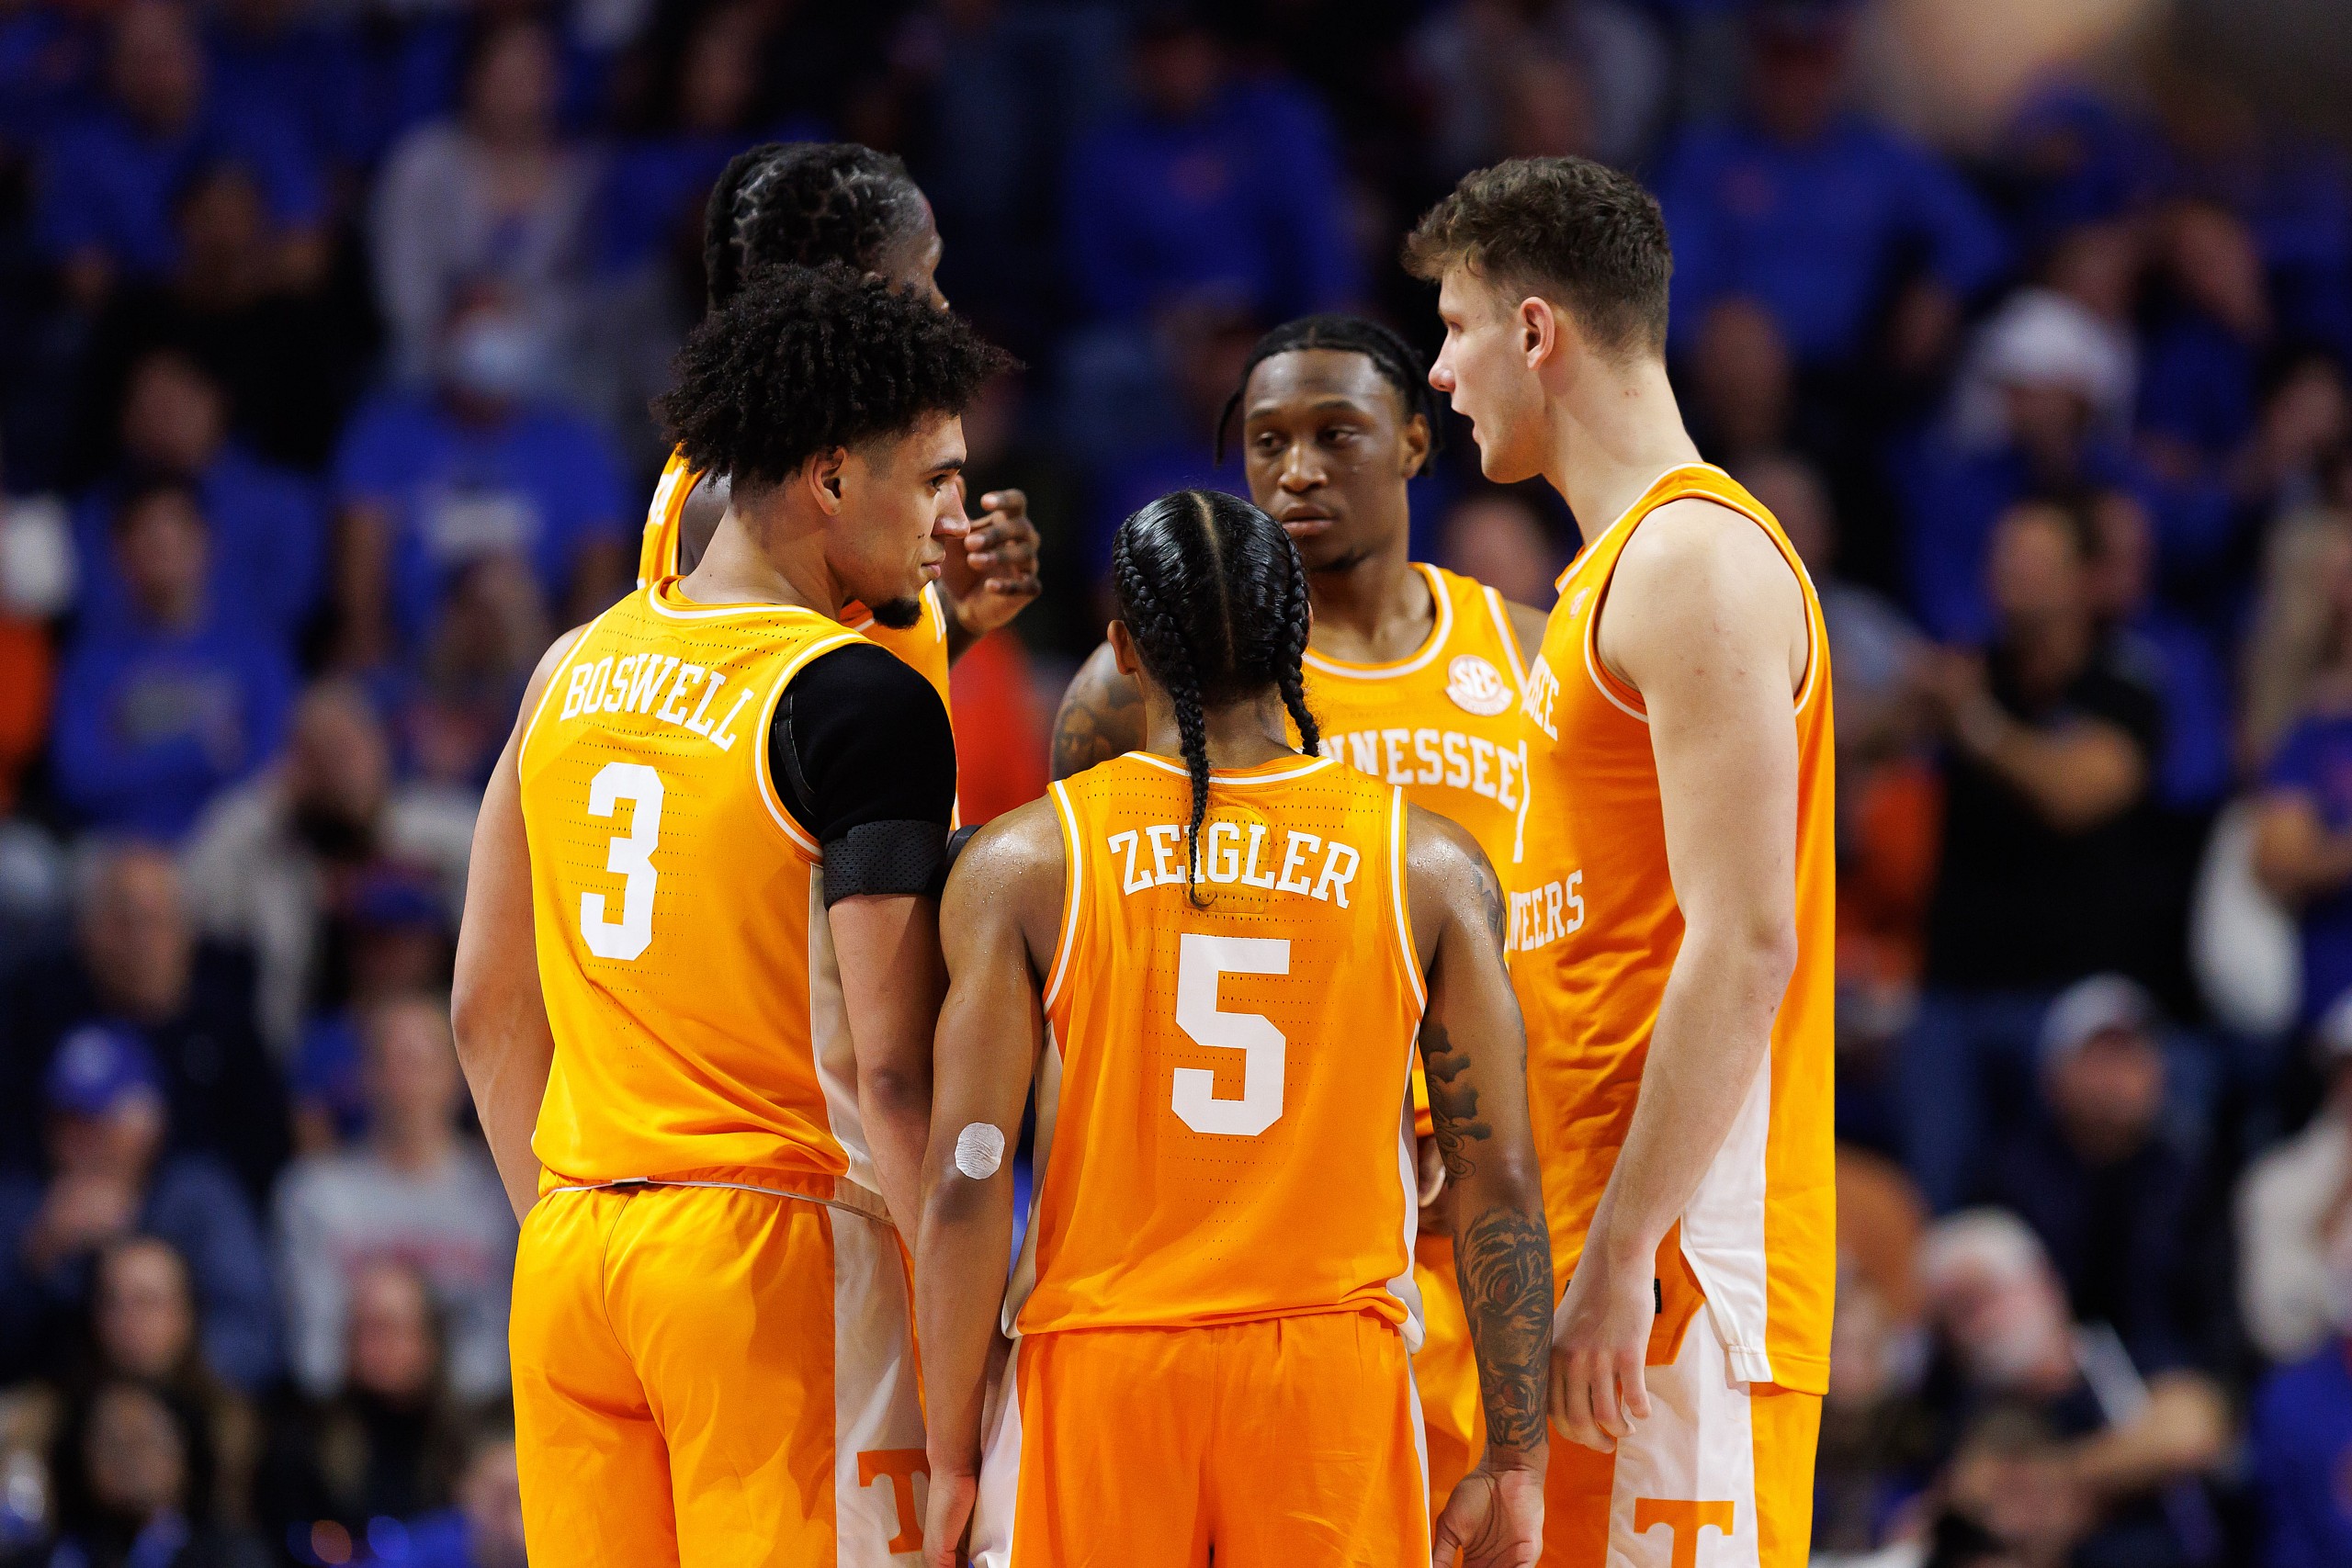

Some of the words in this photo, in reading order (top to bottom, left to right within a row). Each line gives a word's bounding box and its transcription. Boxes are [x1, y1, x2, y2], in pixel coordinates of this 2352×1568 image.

[560, 653, 754, 752] BOSWELL
[1454, 660, 1498, 699] SEC
[580, 761, 664, 961] 3
[1107, 822, 1361, 909] ZEIGLER
[1171, 933, 1292, 1137] 5
[856, 1449, 932, 1554] T
[1634, 1497, 1735, 1568] T
